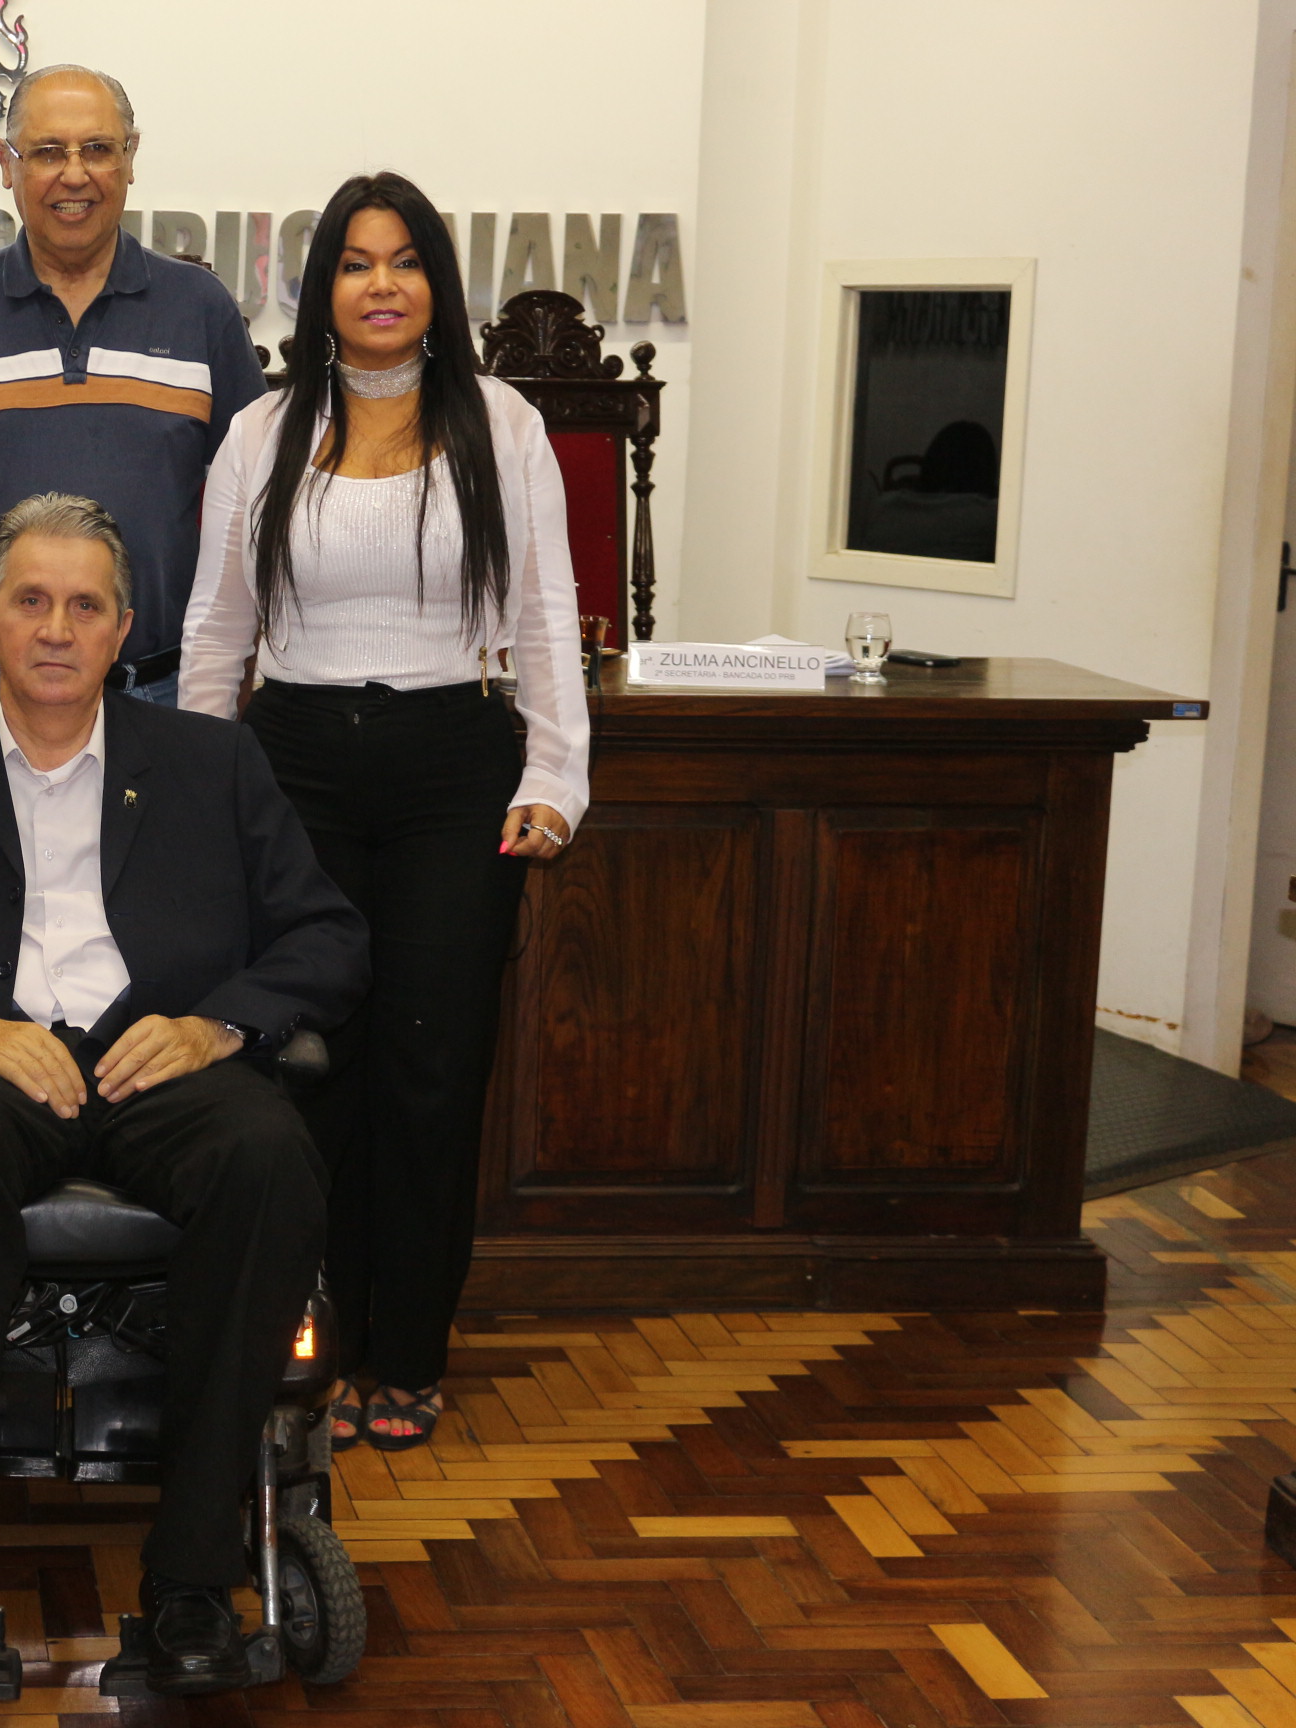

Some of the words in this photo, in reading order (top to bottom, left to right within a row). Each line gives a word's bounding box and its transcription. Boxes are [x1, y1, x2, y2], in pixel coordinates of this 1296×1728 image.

[660, 653, 719, 667] ZULMA
[722, 655, 820, 670] ANCINELLO
[723, 671, 762, 680] BANCADA
[764, 672, 777, 680] DO
[779, 672, 796, 681] PRB
